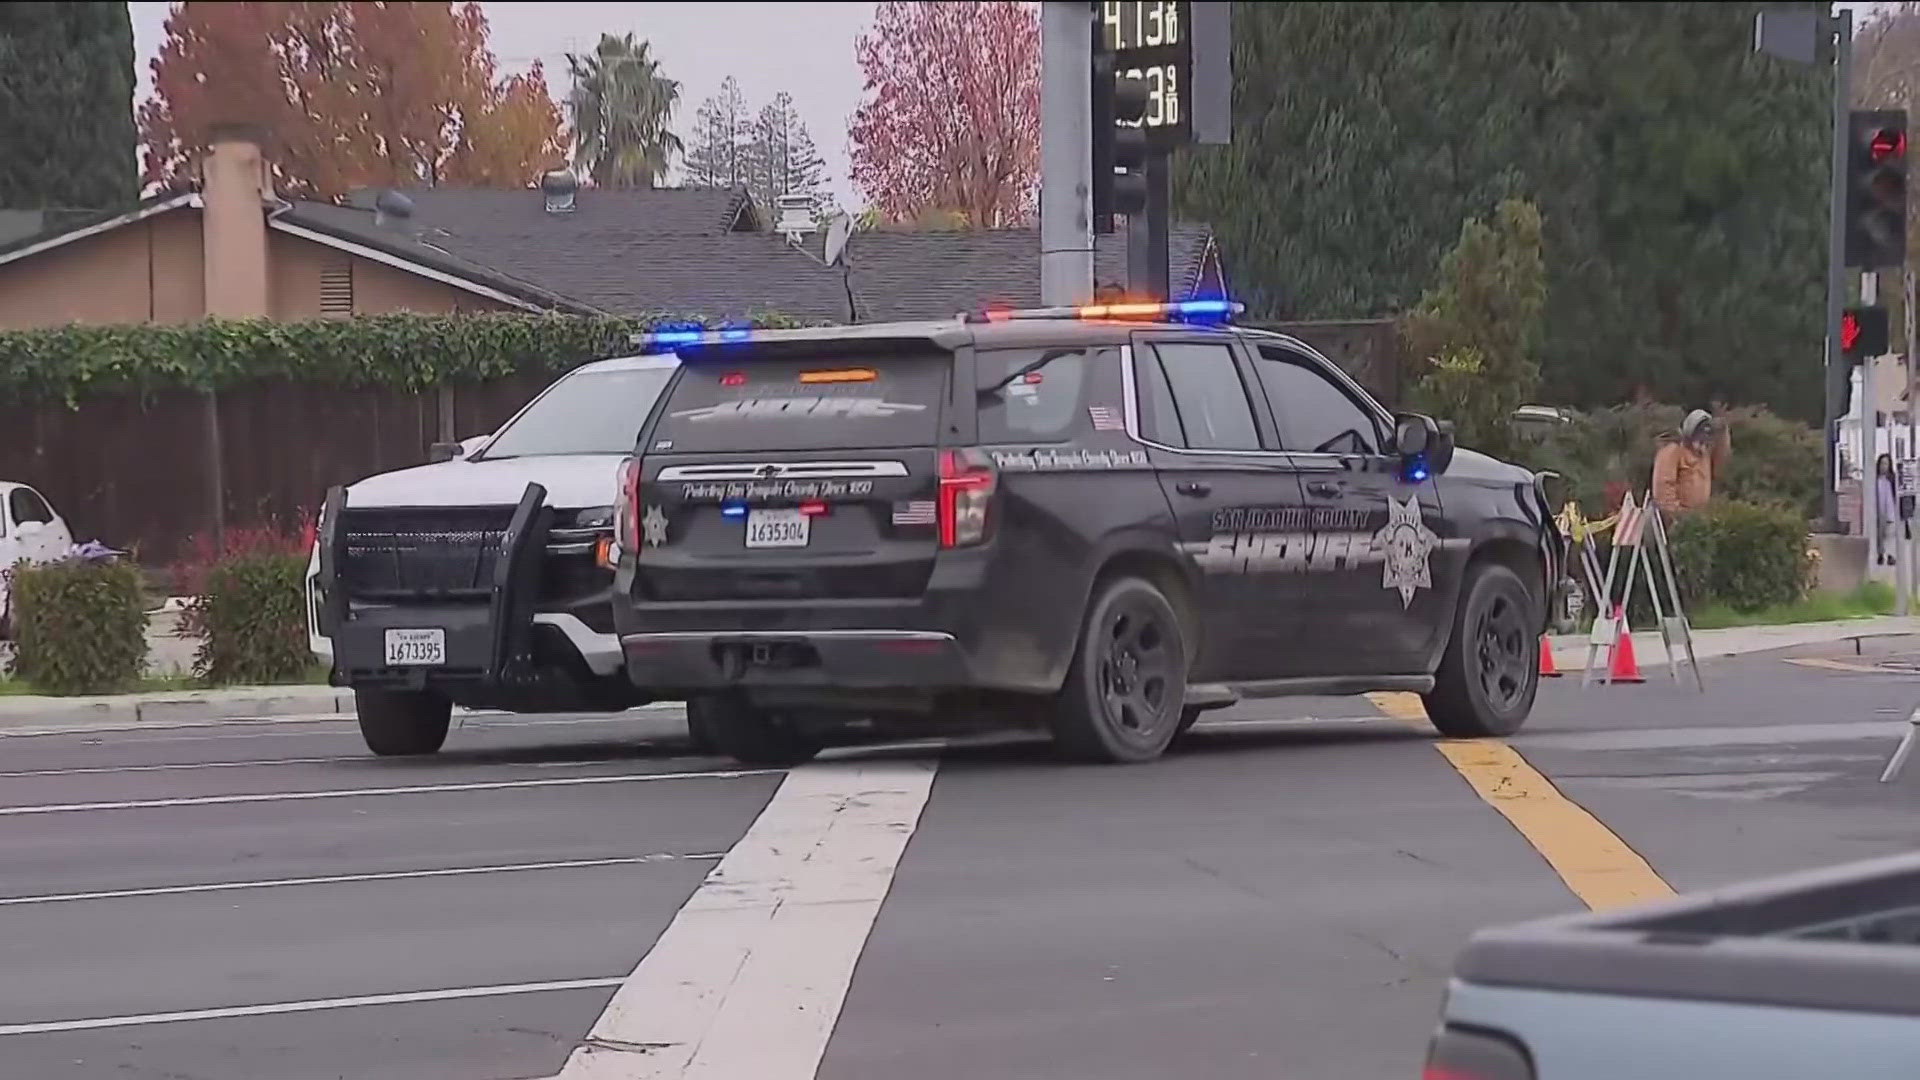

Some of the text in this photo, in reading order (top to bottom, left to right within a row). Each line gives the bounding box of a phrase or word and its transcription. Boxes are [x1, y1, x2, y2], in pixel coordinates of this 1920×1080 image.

[1213, 508, 1370, 530] SAN JOAQUIN COUNTY
[390, 643, 441, 661] 1673395
